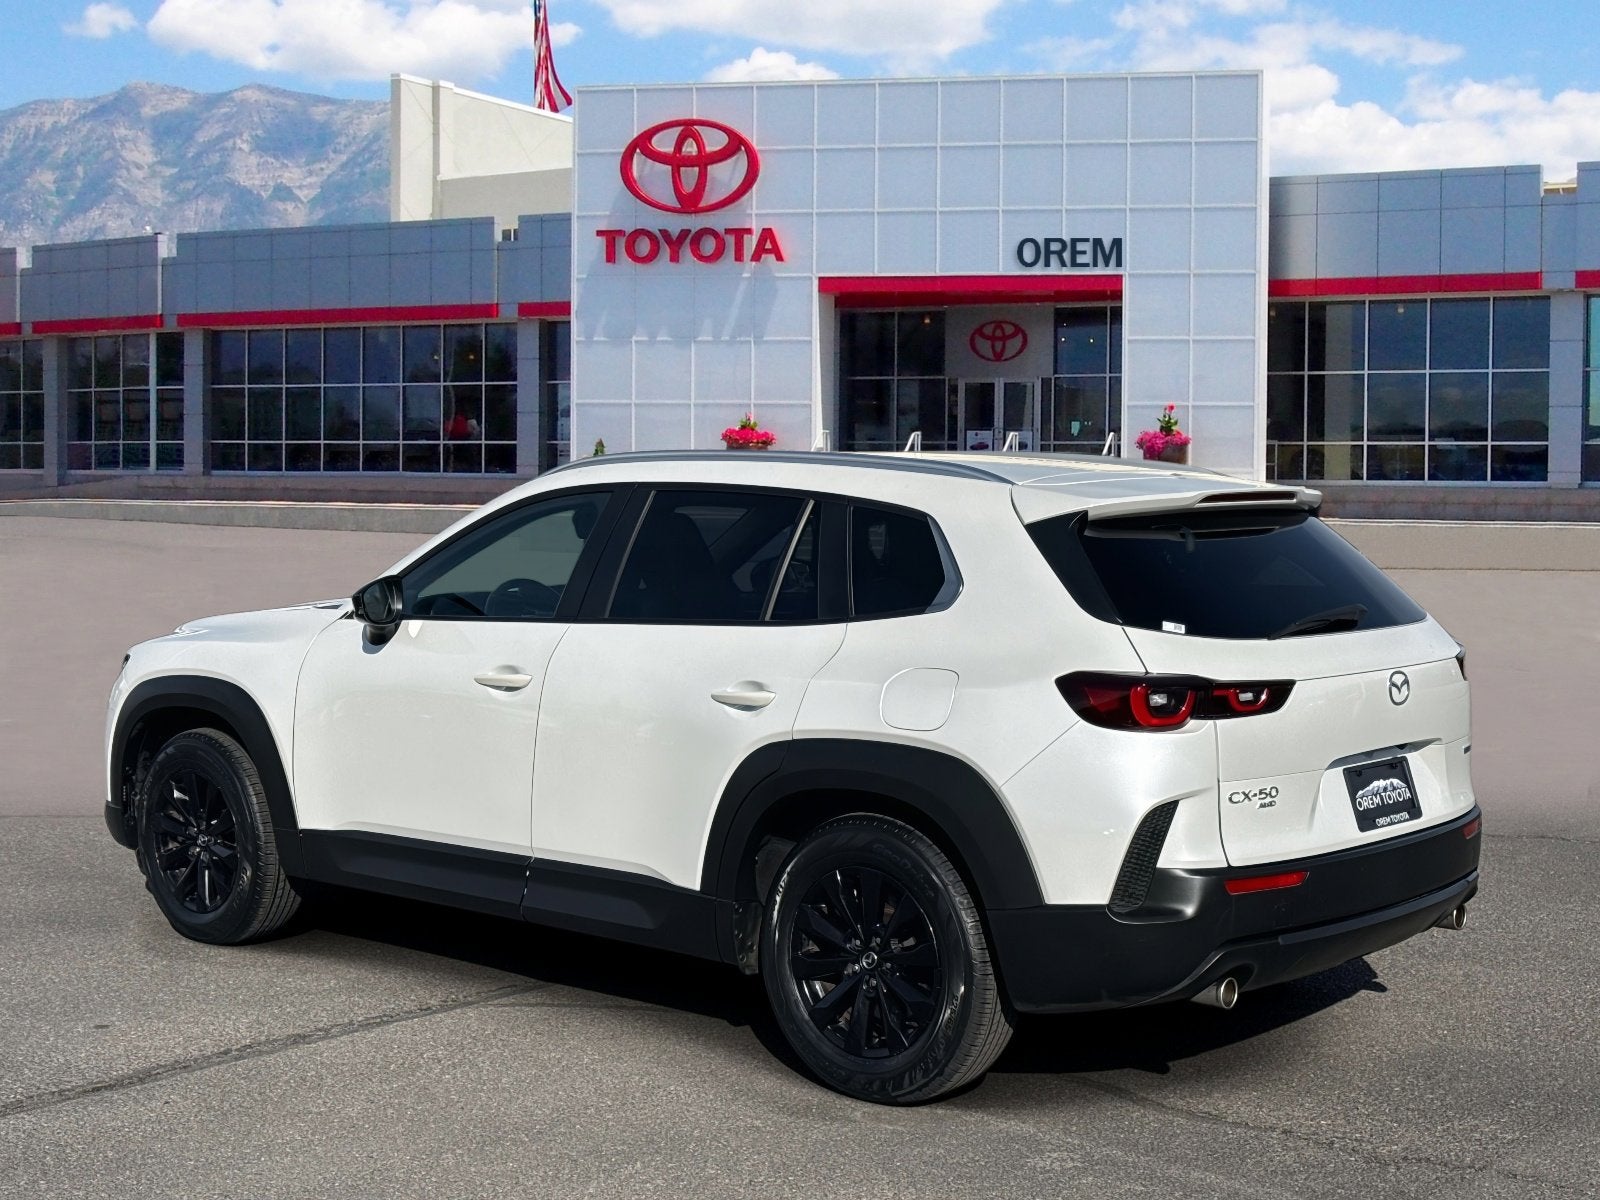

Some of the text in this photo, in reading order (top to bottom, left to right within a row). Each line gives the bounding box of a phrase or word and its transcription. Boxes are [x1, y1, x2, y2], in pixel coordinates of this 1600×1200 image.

[595, 227, 785, 264] TOYOTA
[1016, 237, 1123, 268] OREM
[1228, 786, 1279, 804] CX-50
[1356, 787, 1412, 811] OREM TOYOTA
[1375, 811, 1410, 827] OREM TOYOTA
